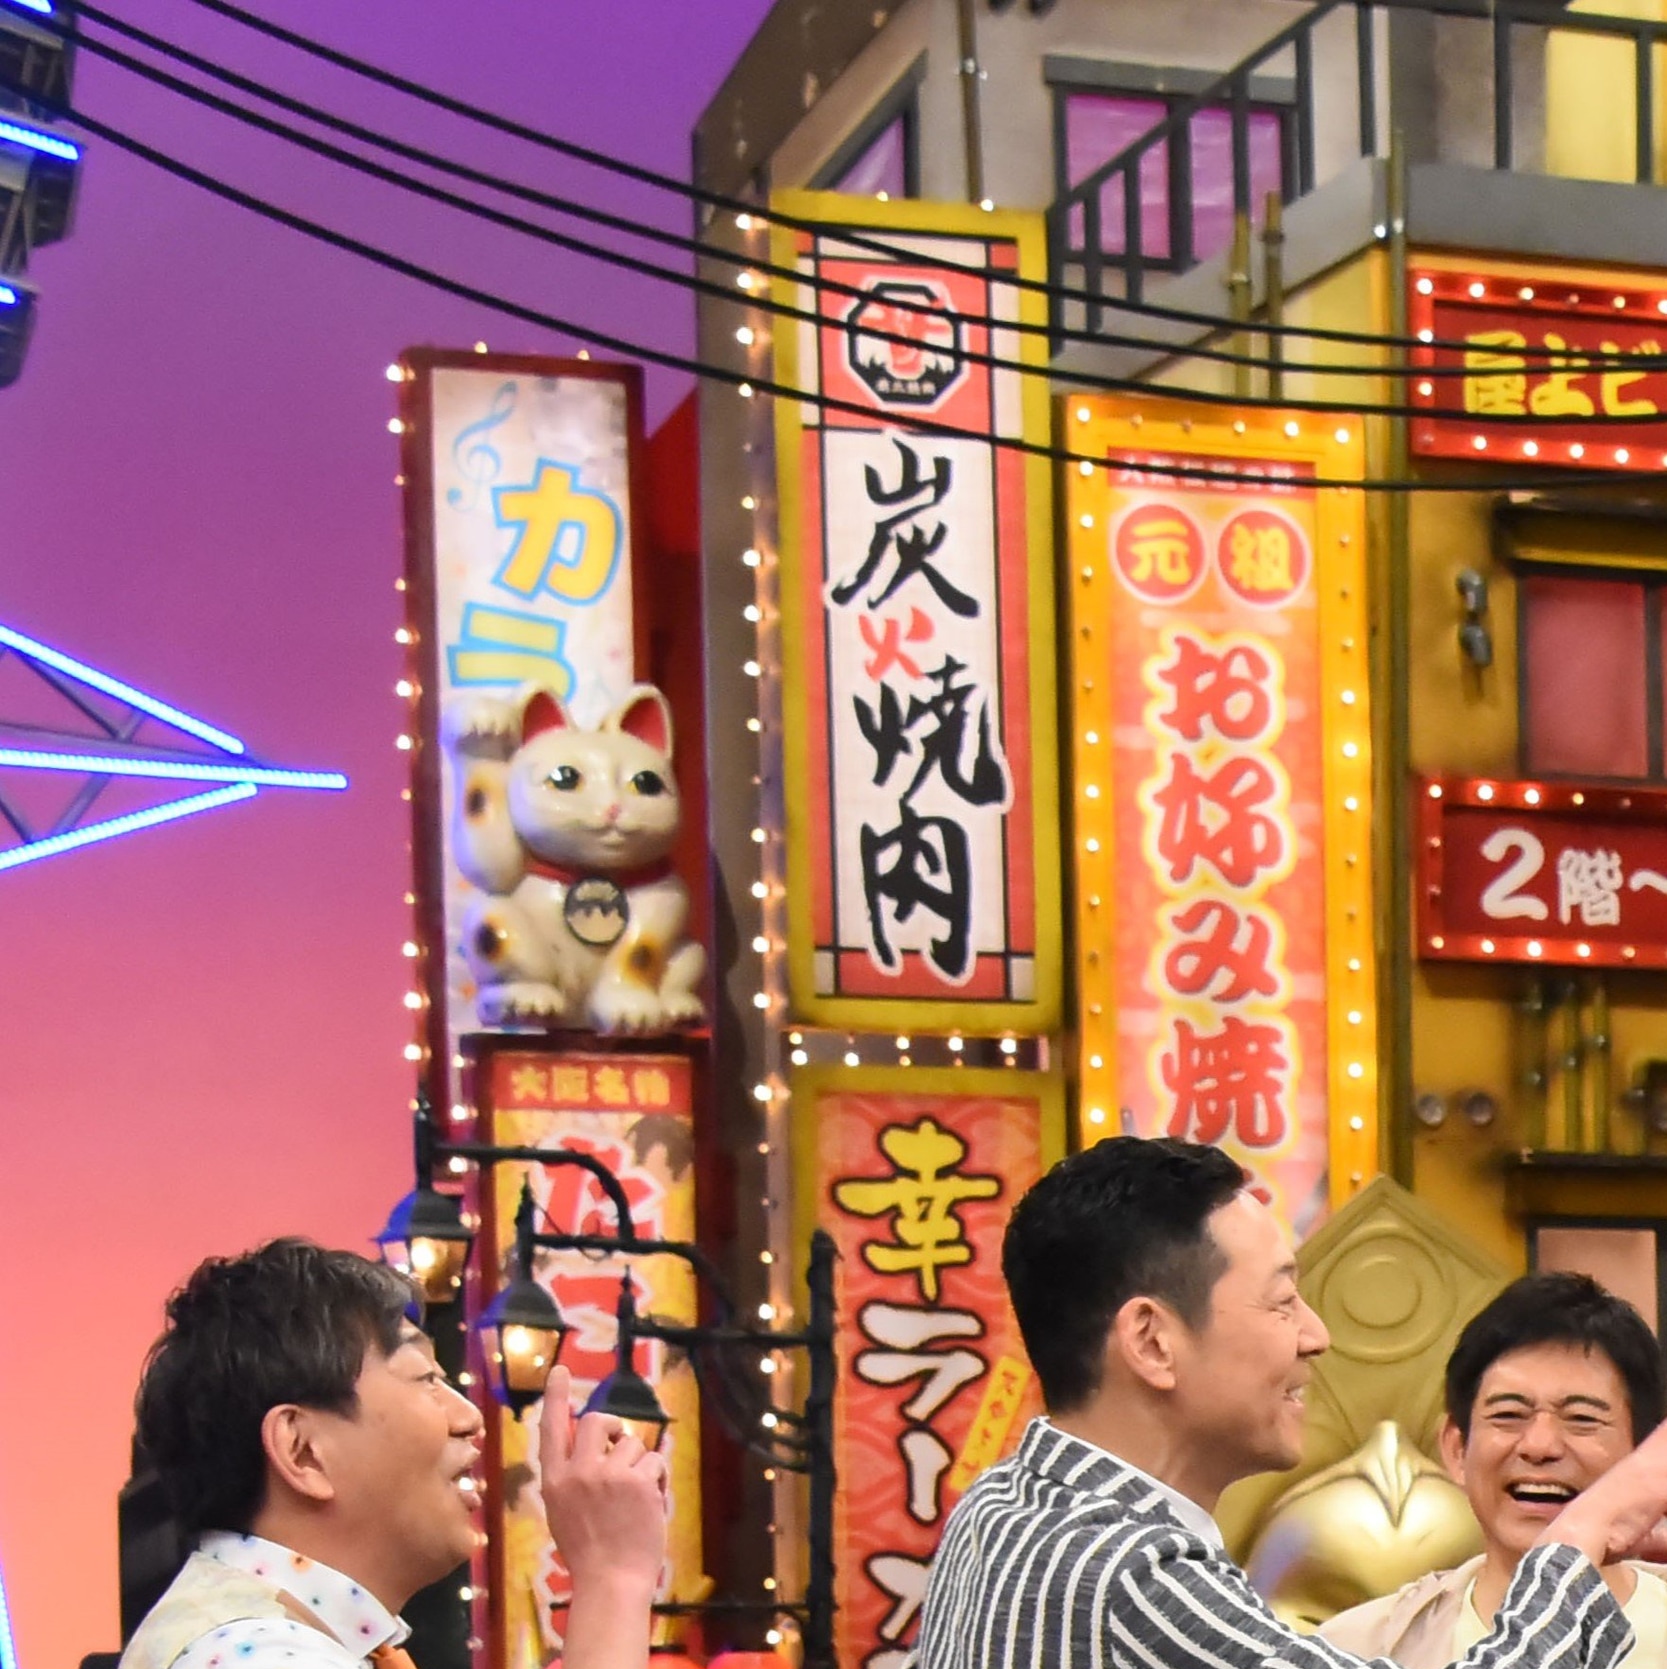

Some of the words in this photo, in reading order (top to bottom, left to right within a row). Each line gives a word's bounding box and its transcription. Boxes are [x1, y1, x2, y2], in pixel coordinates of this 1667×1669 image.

[832, 440, 1005, 970] 炭火焼肉
[1153, 635, 1288, 1150] お好み焼
